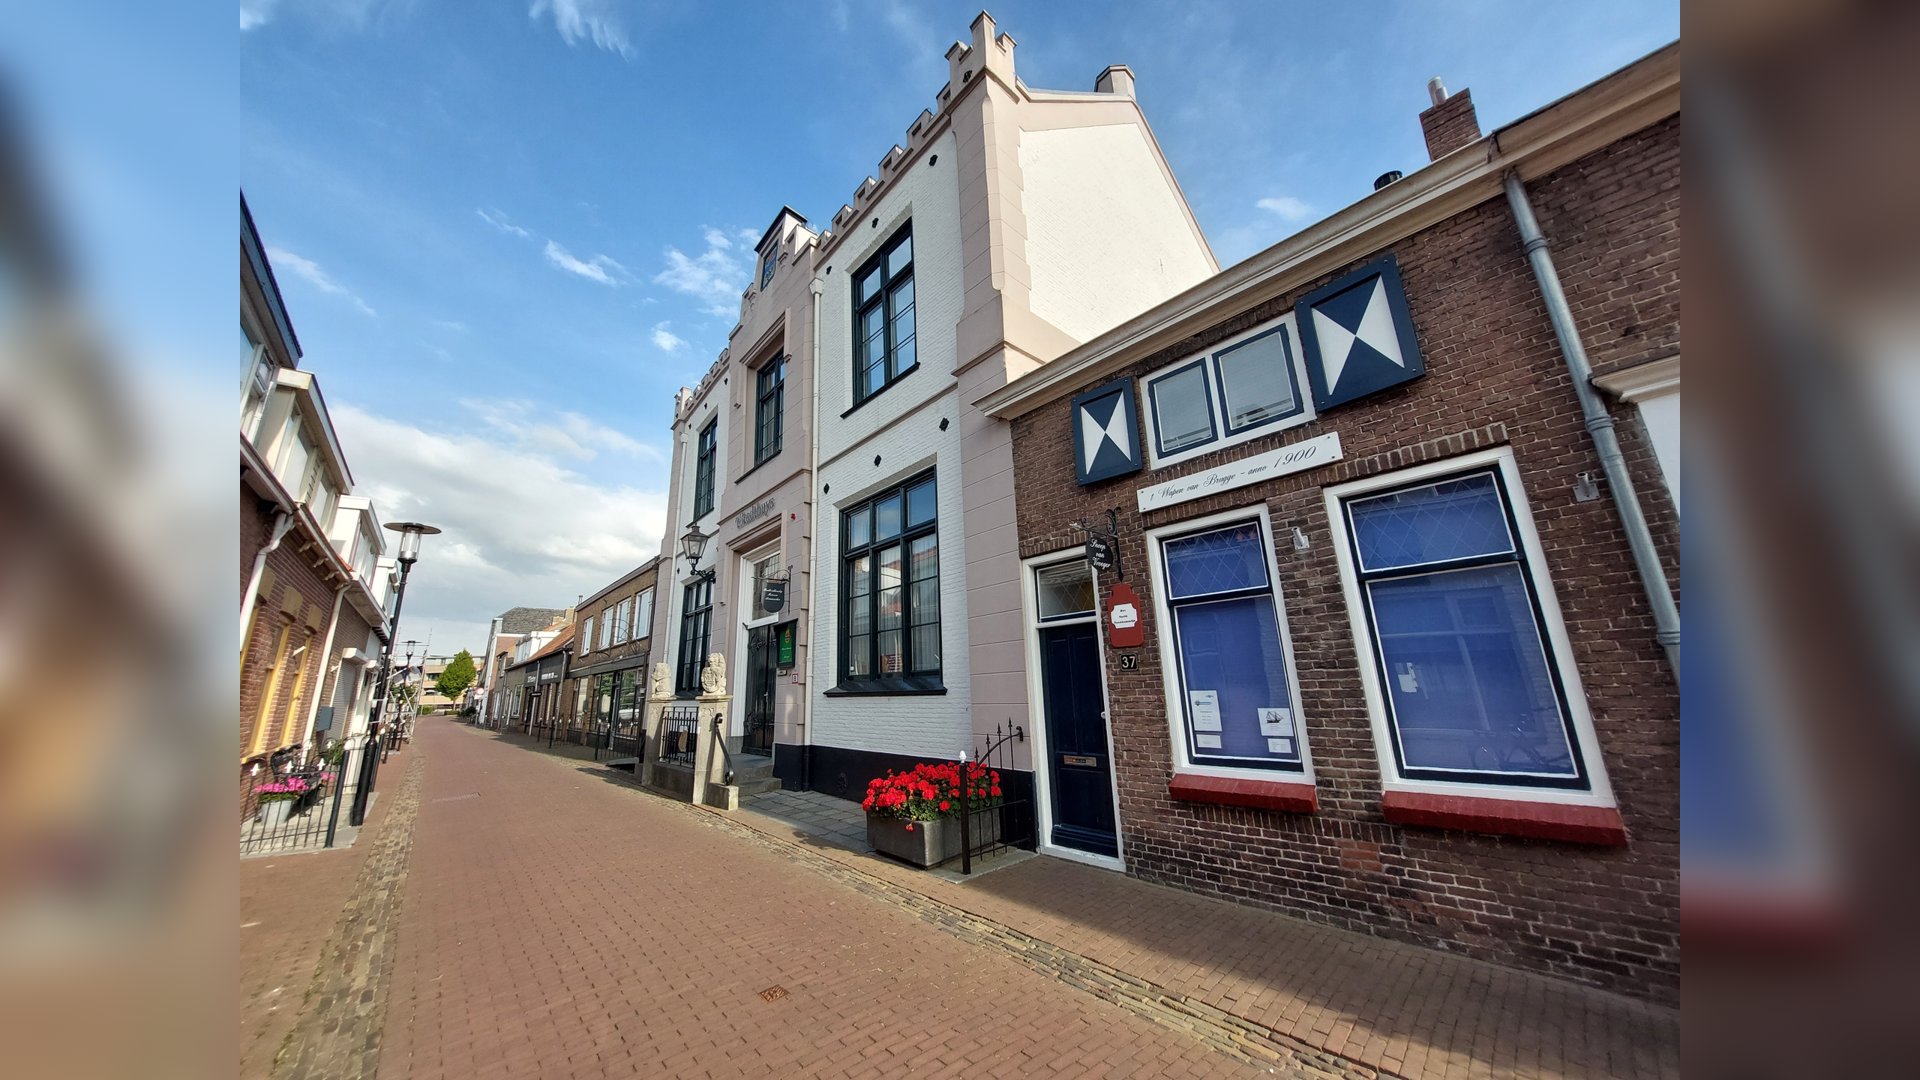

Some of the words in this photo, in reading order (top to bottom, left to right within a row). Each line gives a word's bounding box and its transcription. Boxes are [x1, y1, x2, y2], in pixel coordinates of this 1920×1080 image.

[1158, 484, 1184, 498] Wapen
[1186, 484, 1199, 492] van
[1203, 473, 1236, 487] Brugge
[1248, 465, 1267, 475] anno
[1273, 446, 1317, 469] 1900
[1122, 656, 1136, 669] 37
